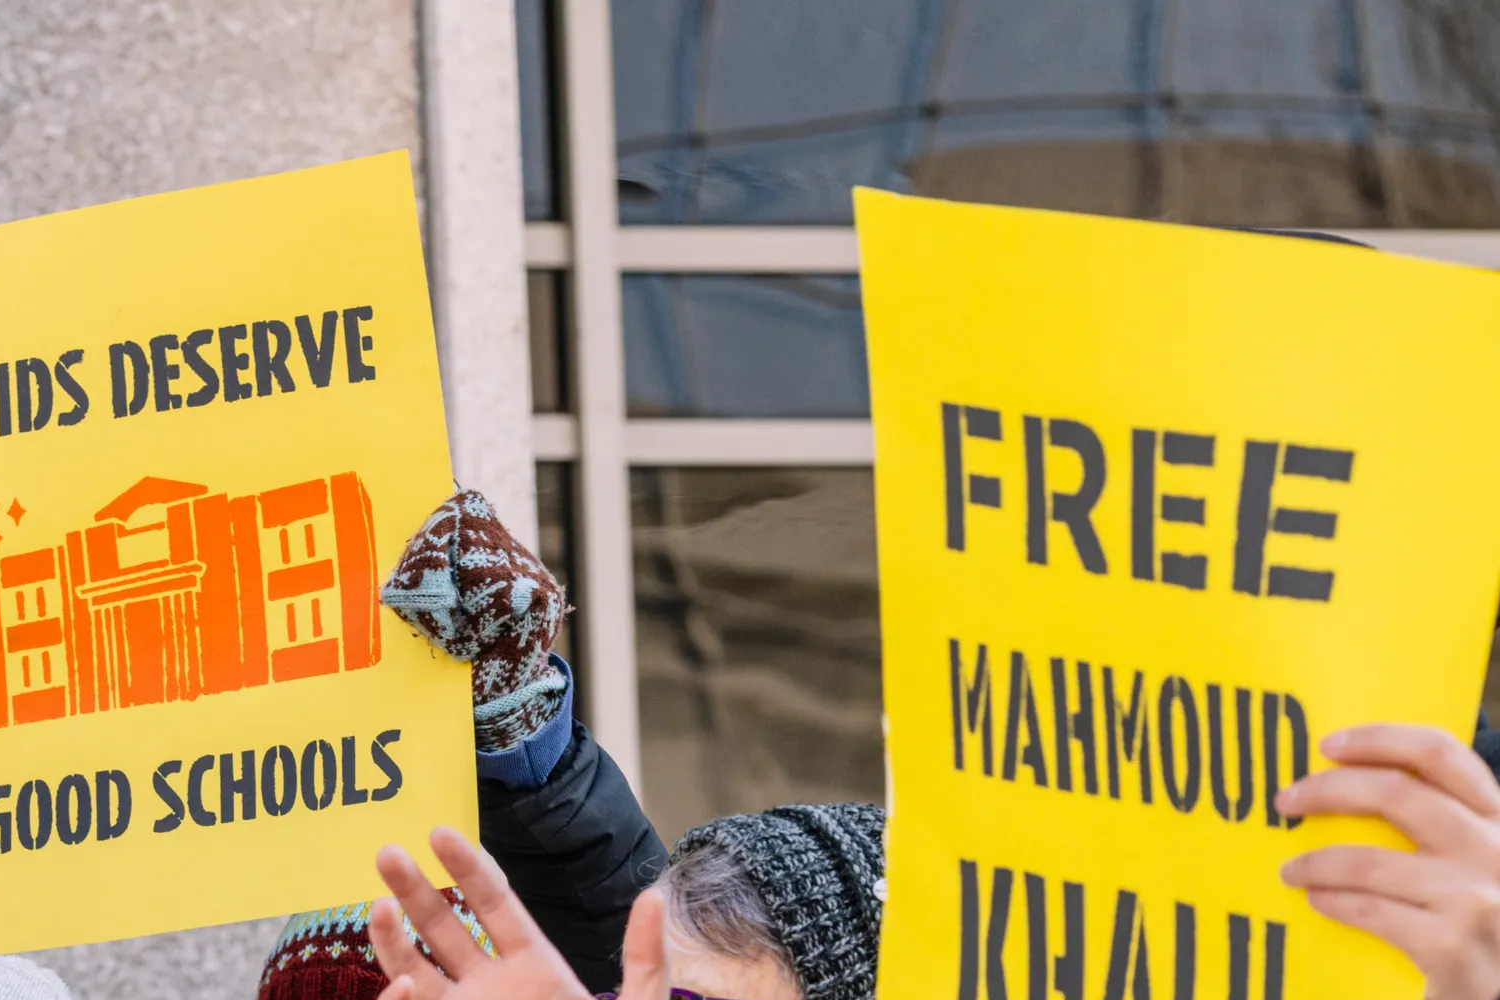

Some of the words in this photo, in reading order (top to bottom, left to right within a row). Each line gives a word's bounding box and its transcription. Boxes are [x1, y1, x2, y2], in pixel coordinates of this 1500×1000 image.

[108, 305, 377, 419] DESERVE
[941, 402, 1355, 602] FREE
[152, 729, 404, 834] SCHOOLS
[948, 638, 1310, 831] MAHMOUD
